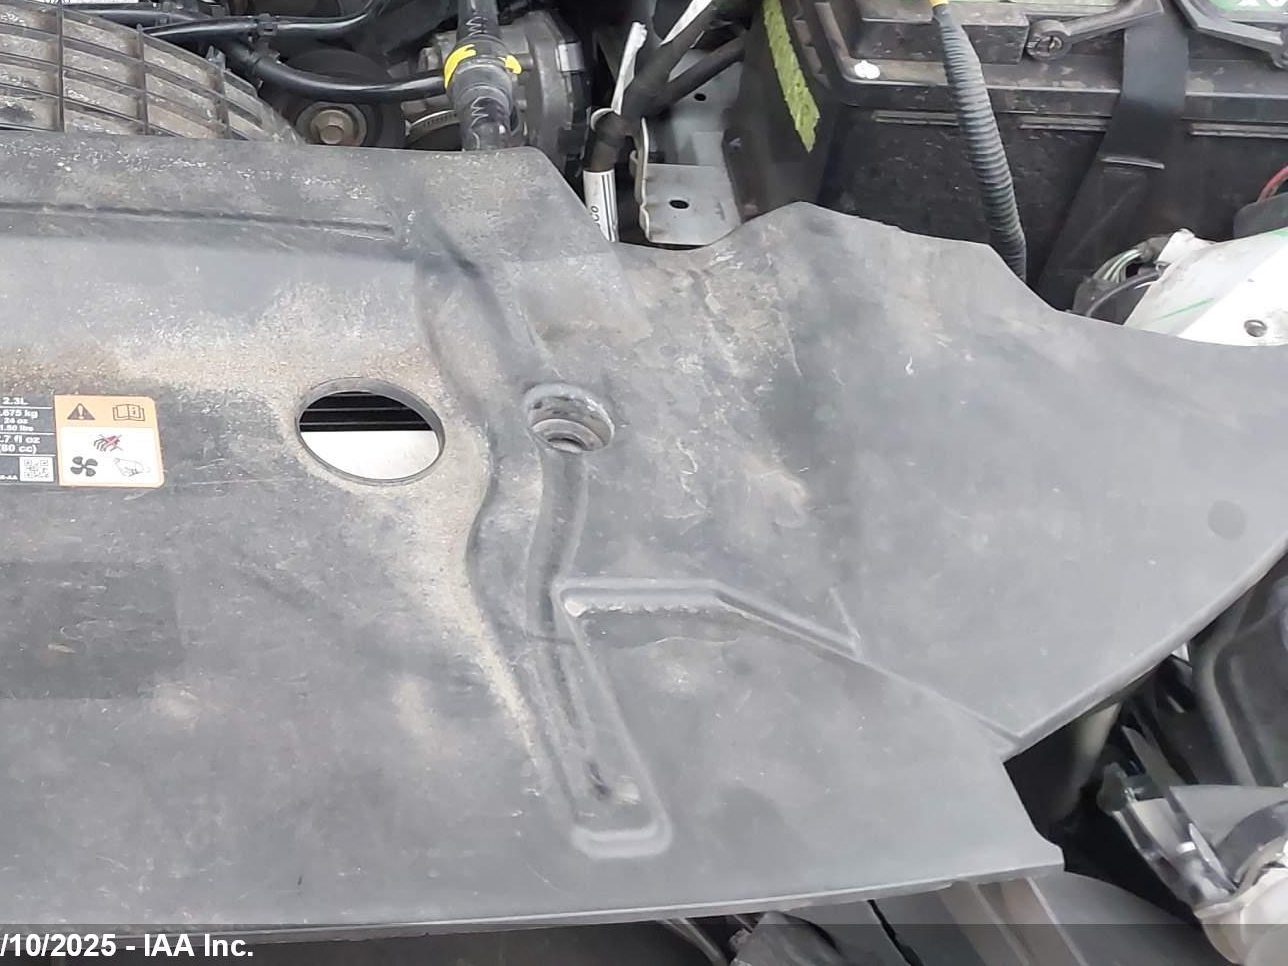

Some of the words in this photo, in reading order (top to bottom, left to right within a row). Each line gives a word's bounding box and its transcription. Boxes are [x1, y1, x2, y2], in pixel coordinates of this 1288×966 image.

[2, 396, 29, 405] 2.3L
[24, 409, 39, 419] kg
[25, 436, 41, 444] oz
[18, 444, 38, 455] cc)
